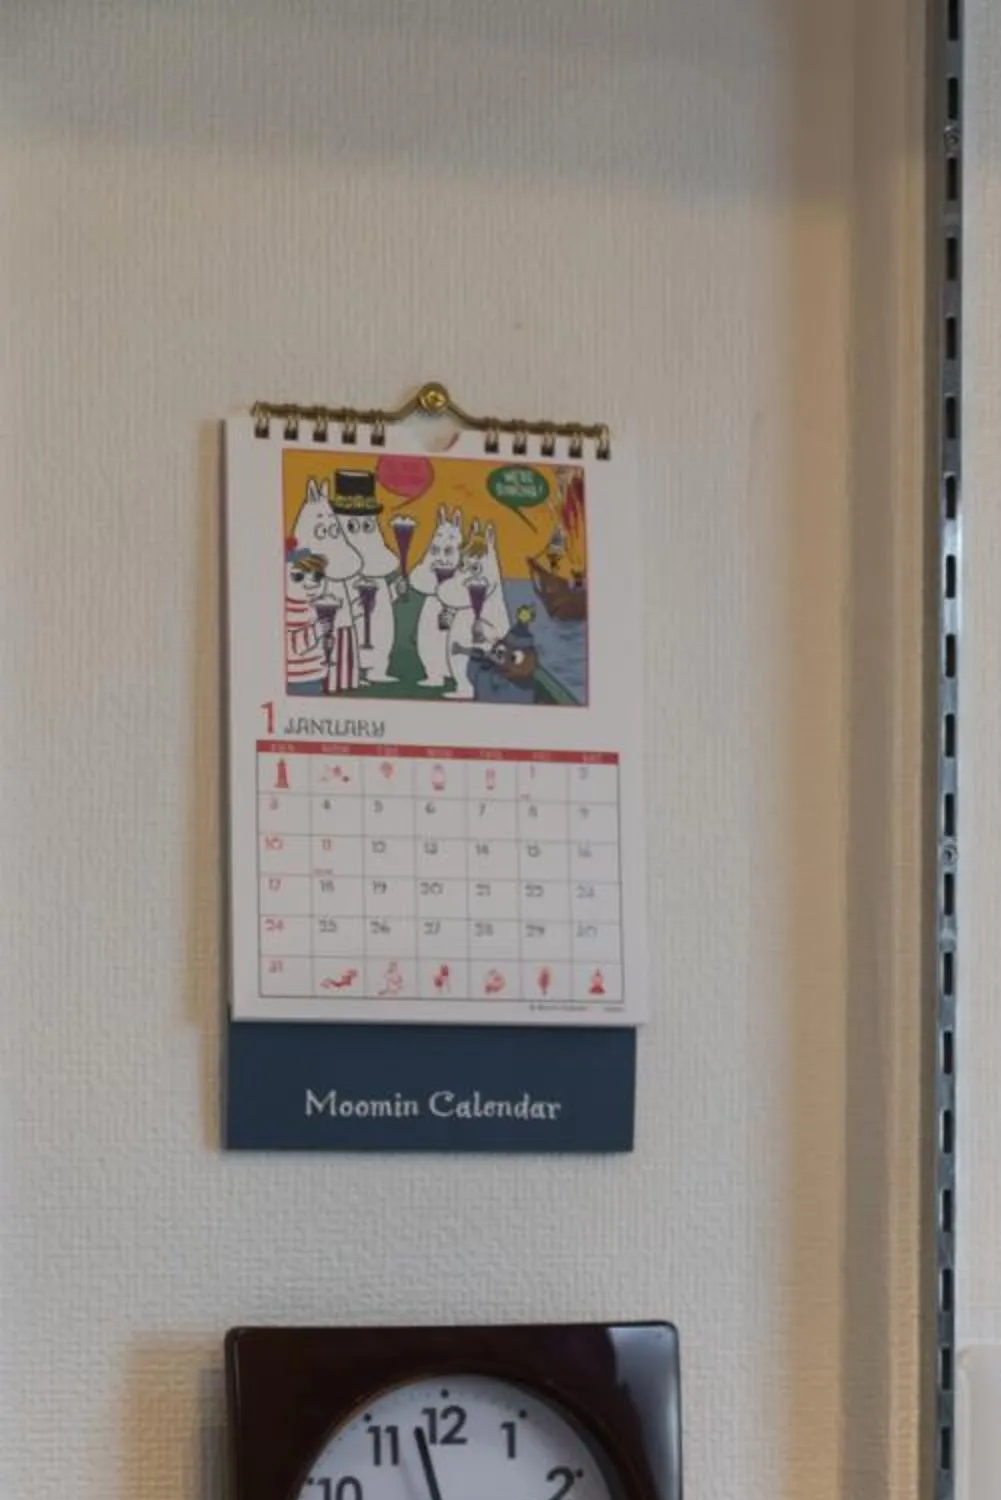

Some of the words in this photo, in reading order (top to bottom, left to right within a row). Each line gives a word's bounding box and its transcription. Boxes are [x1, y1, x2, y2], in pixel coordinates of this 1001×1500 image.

[261, 702, 275, 735] 1
[284, 716, 385, 738] JANUARY
[304, 1088, 419, 1119] Moomin
[429, 1090, 562, 1121] Calendar
[422, 1405, 467, 1446] 12
[501, 1422, 518, 1459] 1
[367, 1425, 400, 1467] 11
